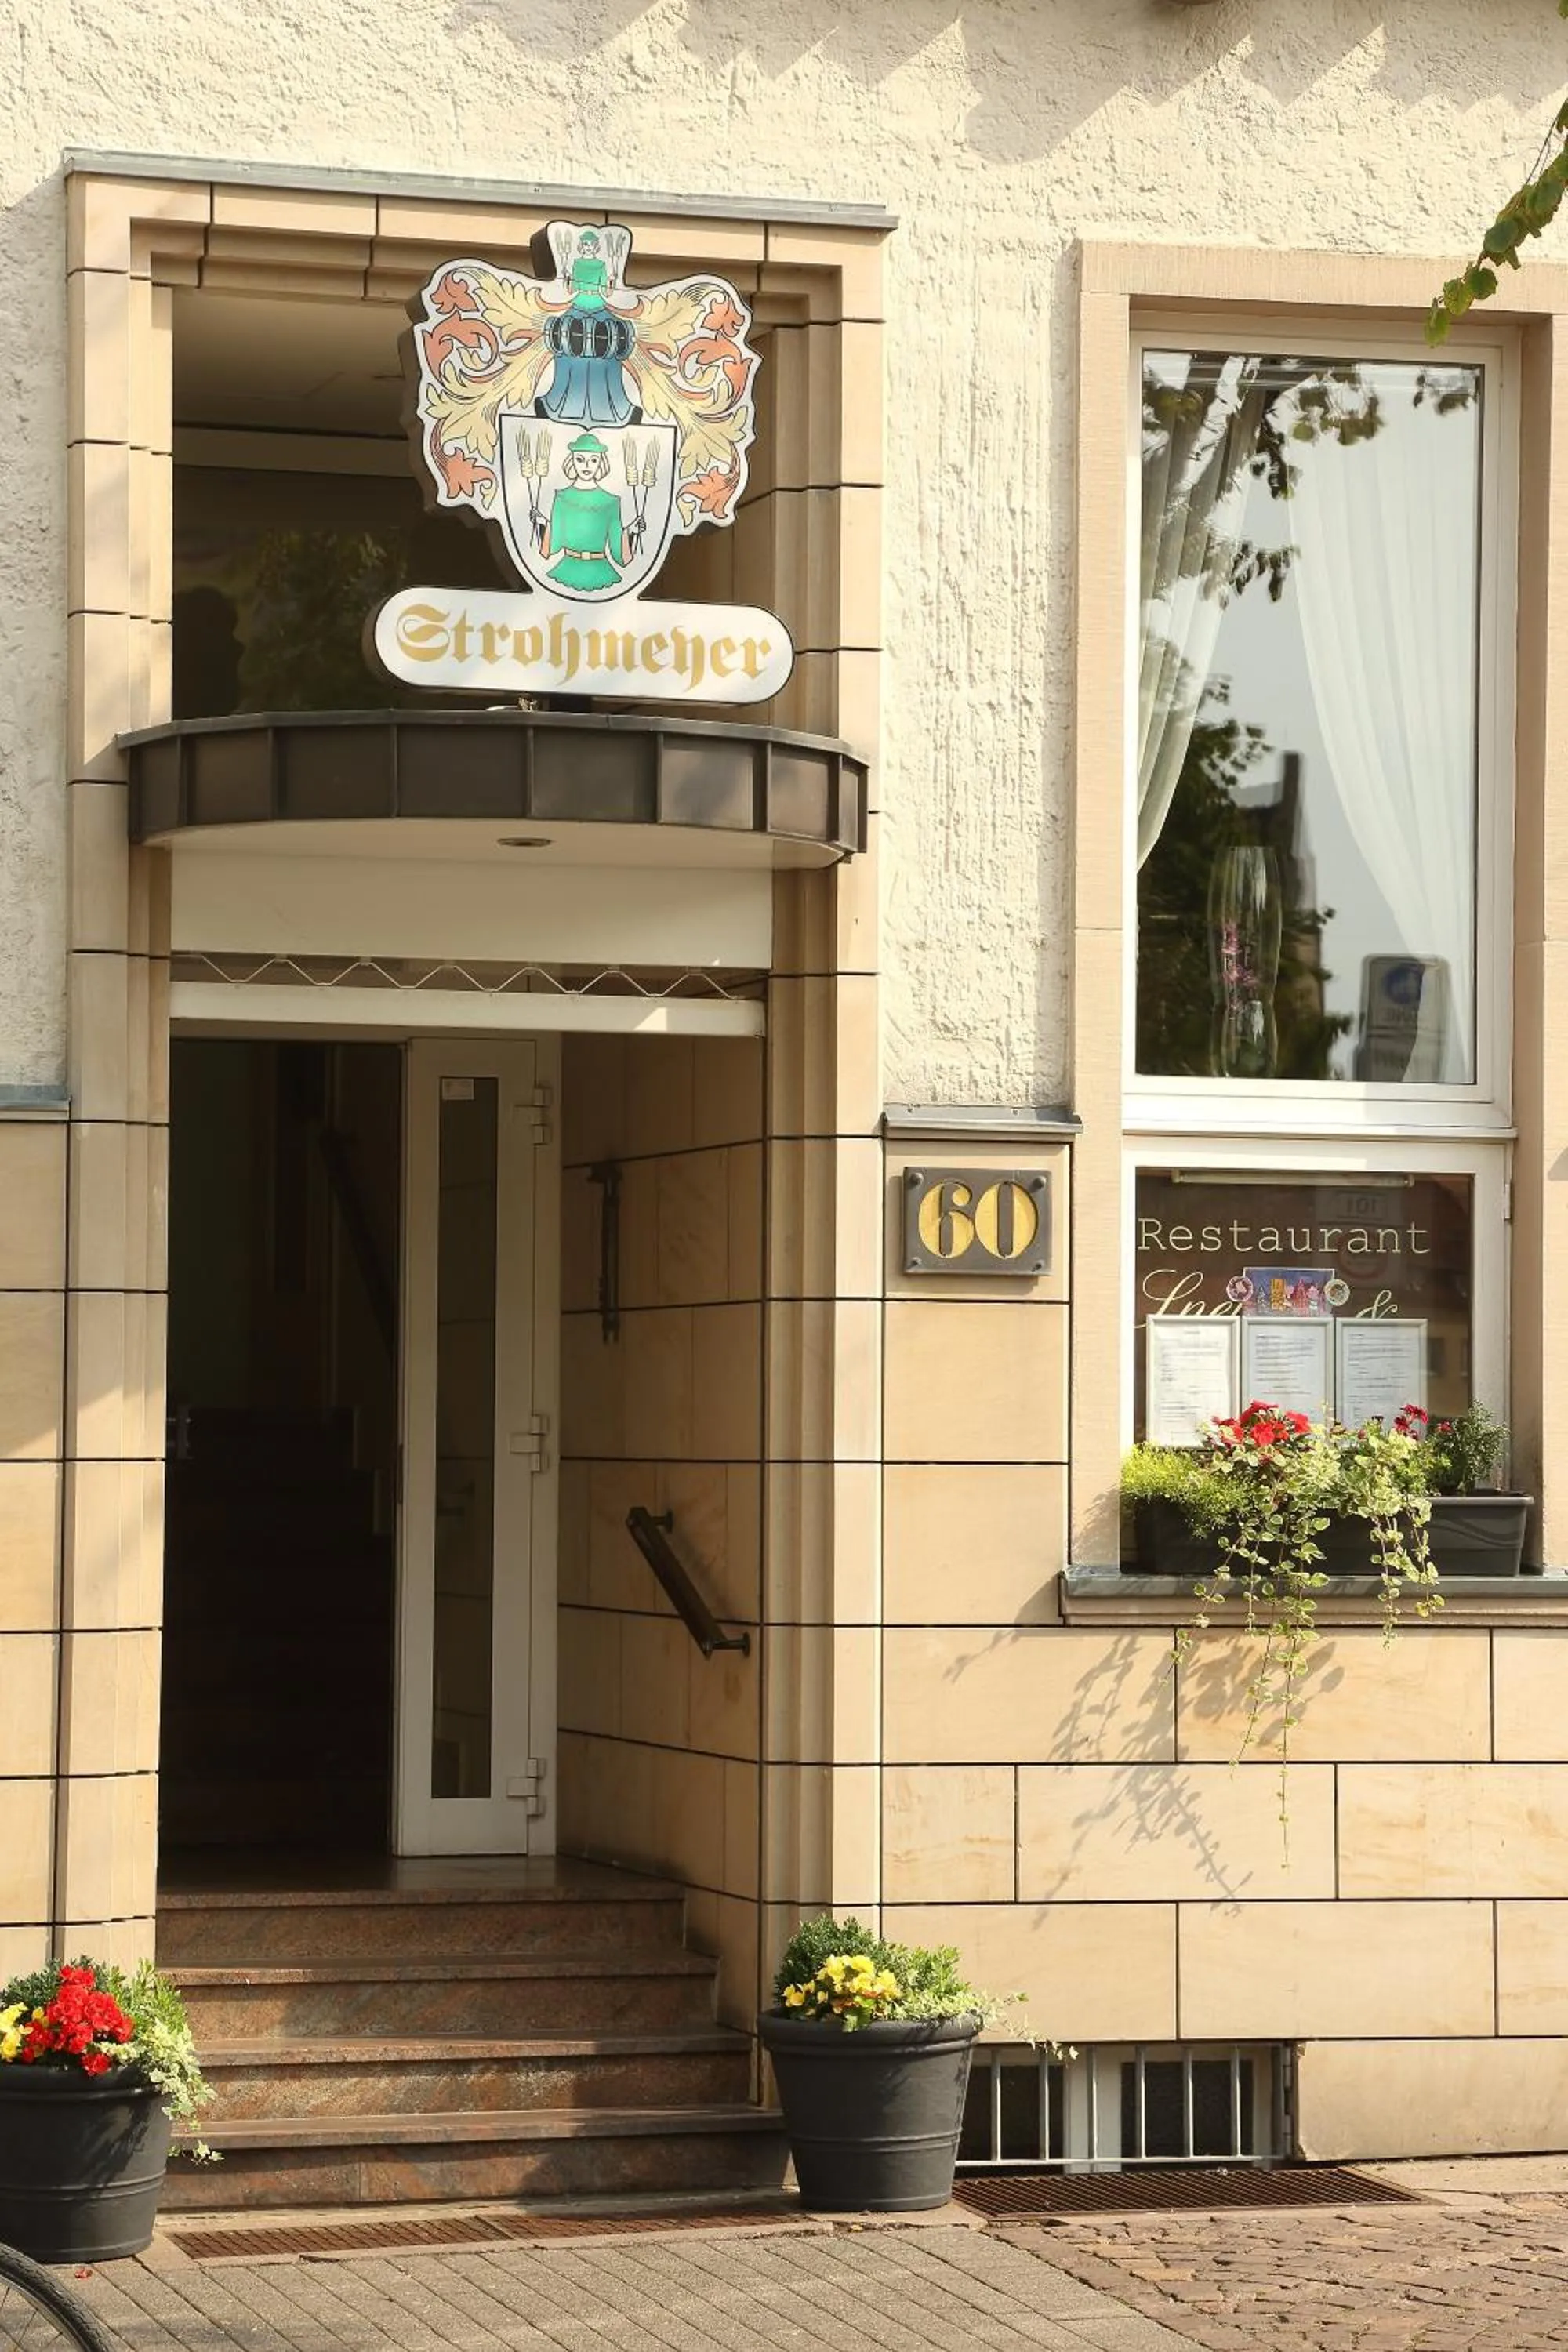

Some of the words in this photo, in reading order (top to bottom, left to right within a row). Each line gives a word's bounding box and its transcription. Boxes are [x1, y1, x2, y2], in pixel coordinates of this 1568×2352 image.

[395, 603, 773, 692] Strohmeyer
[918, 1178, 1039, 1260] 60
[1137, 1218, 1431, 1254] Restaurant
